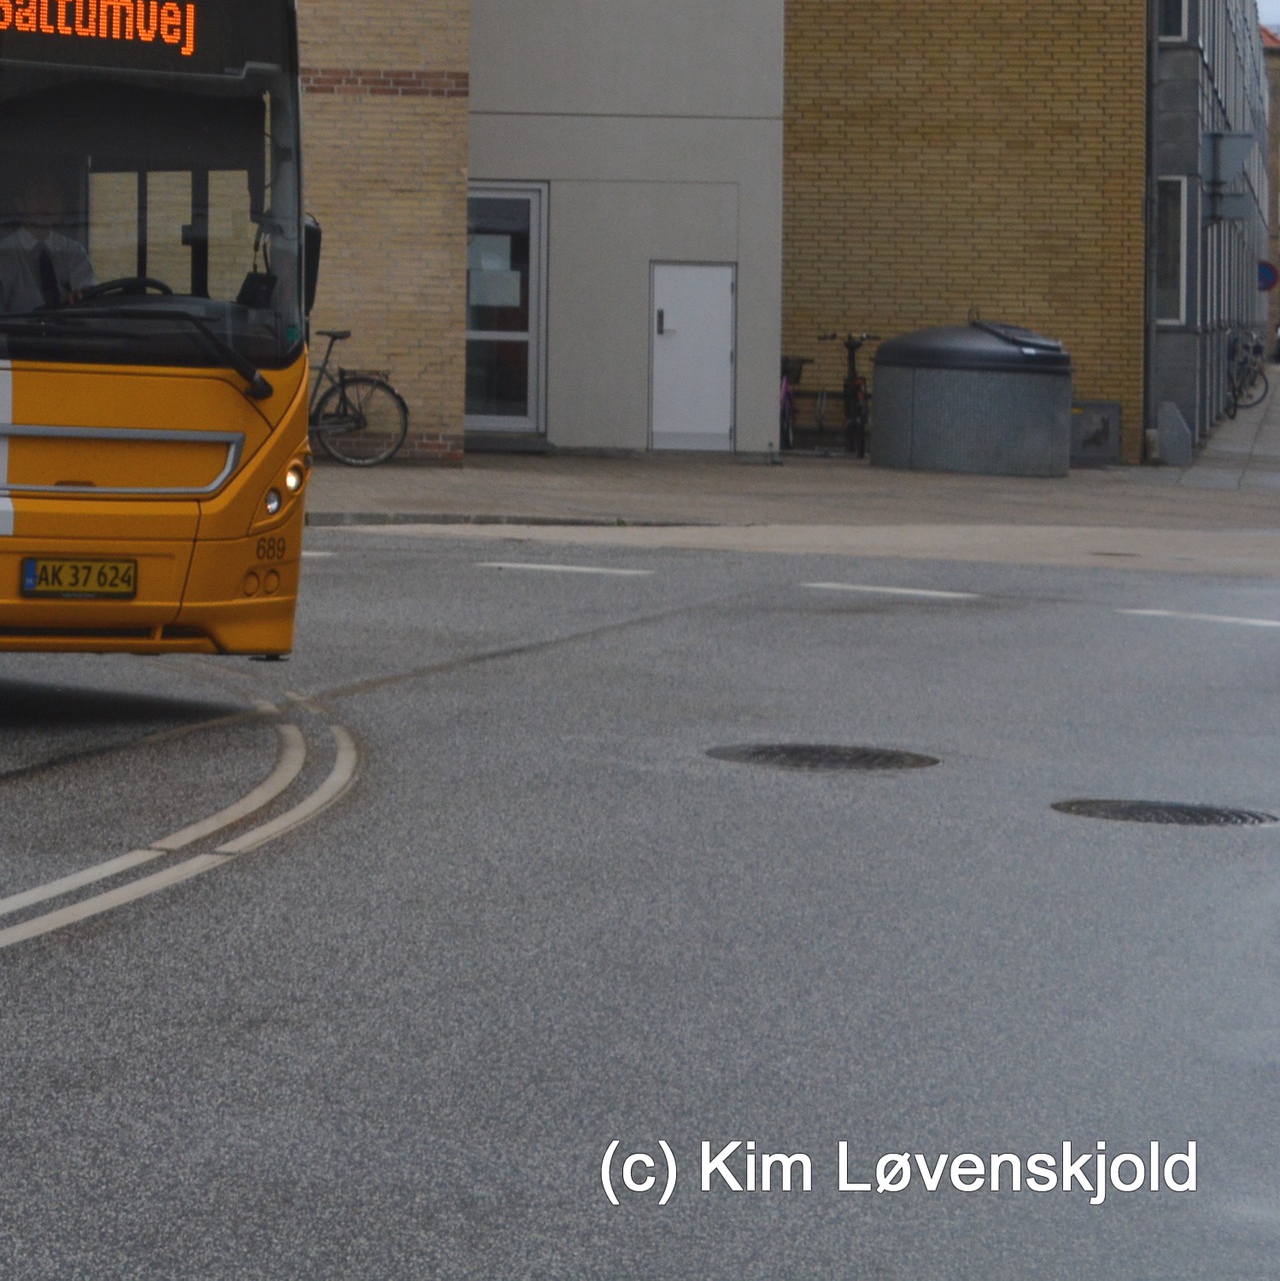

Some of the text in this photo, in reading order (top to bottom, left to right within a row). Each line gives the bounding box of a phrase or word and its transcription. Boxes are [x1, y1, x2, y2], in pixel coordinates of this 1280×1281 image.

[256, 536, 286, 560] 689
[38, 564, 133, 588] AK 37 624
